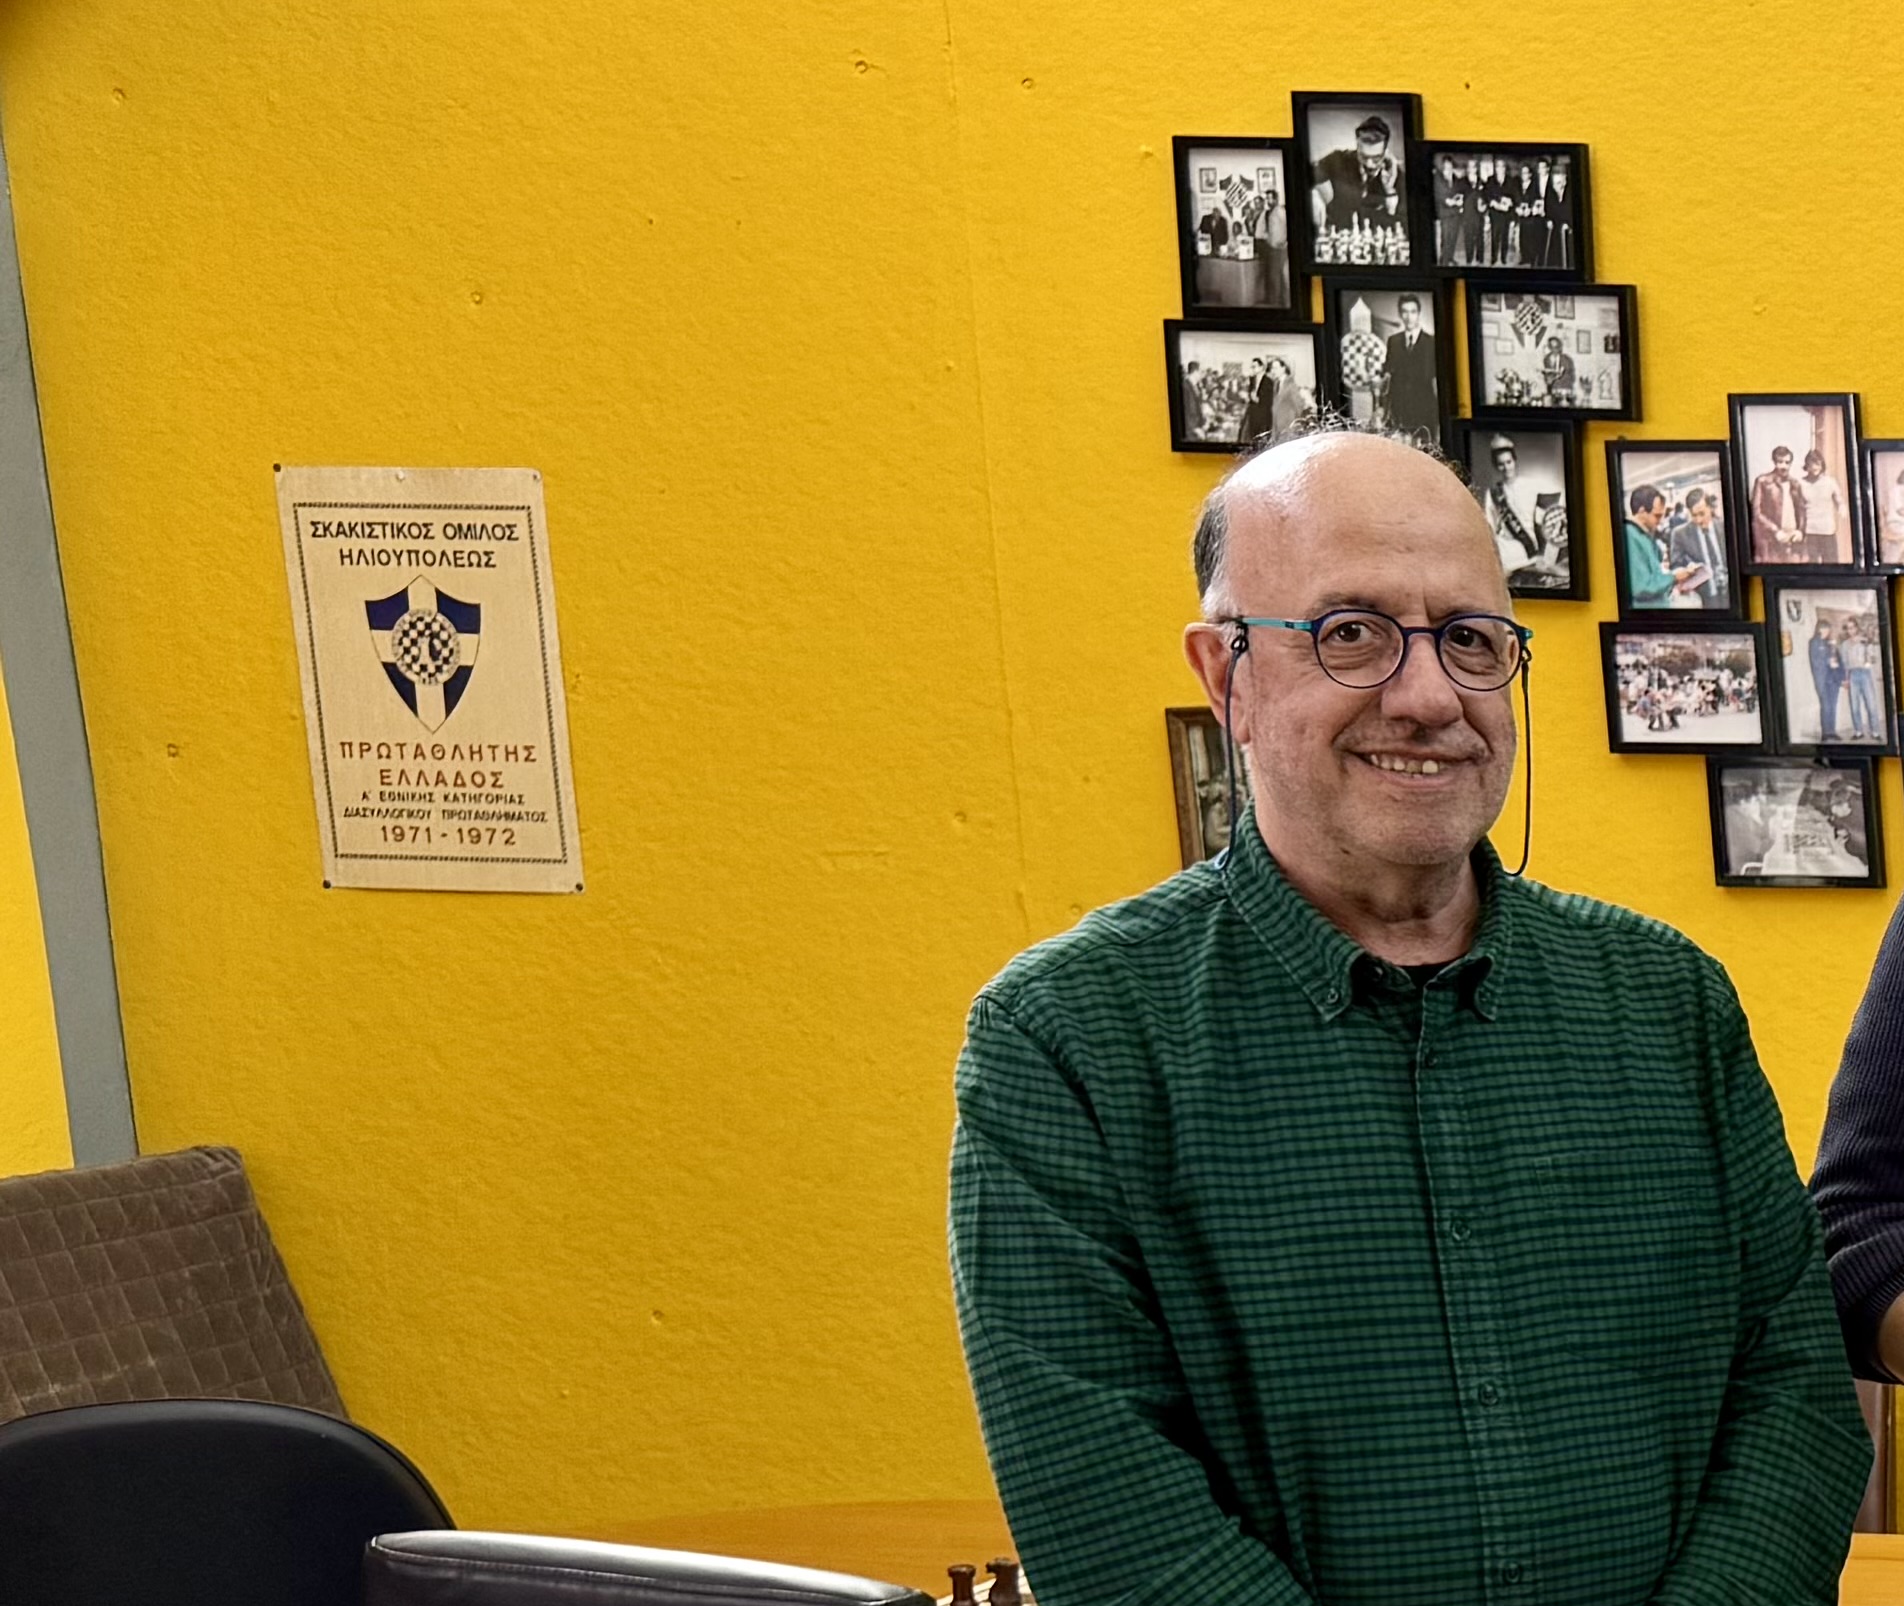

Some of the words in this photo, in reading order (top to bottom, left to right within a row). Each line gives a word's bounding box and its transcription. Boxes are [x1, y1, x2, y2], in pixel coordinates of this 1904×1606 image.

[309, 519, 435, 541] ΣΚΑΚΙΣΤΙΚΟΣ
[442, 522, 520, 542] ΟΜΙΛΟΣ
[338, 547, 498, 569] ΗΛΙΟΥΠΟΛΕΩΣ
[339, 741, 538, 763] ΠΡΩΤΑΘΛΗΤΗΣ
[379, 768, 505, 789] ΕΛΛΑΔΟΣ
[379, 790, 436, 804] ΕΘΝΙΚΗΣ
[442, 791, 526, 806] ΚΑΤΗΓΟΡΙΑΣ
